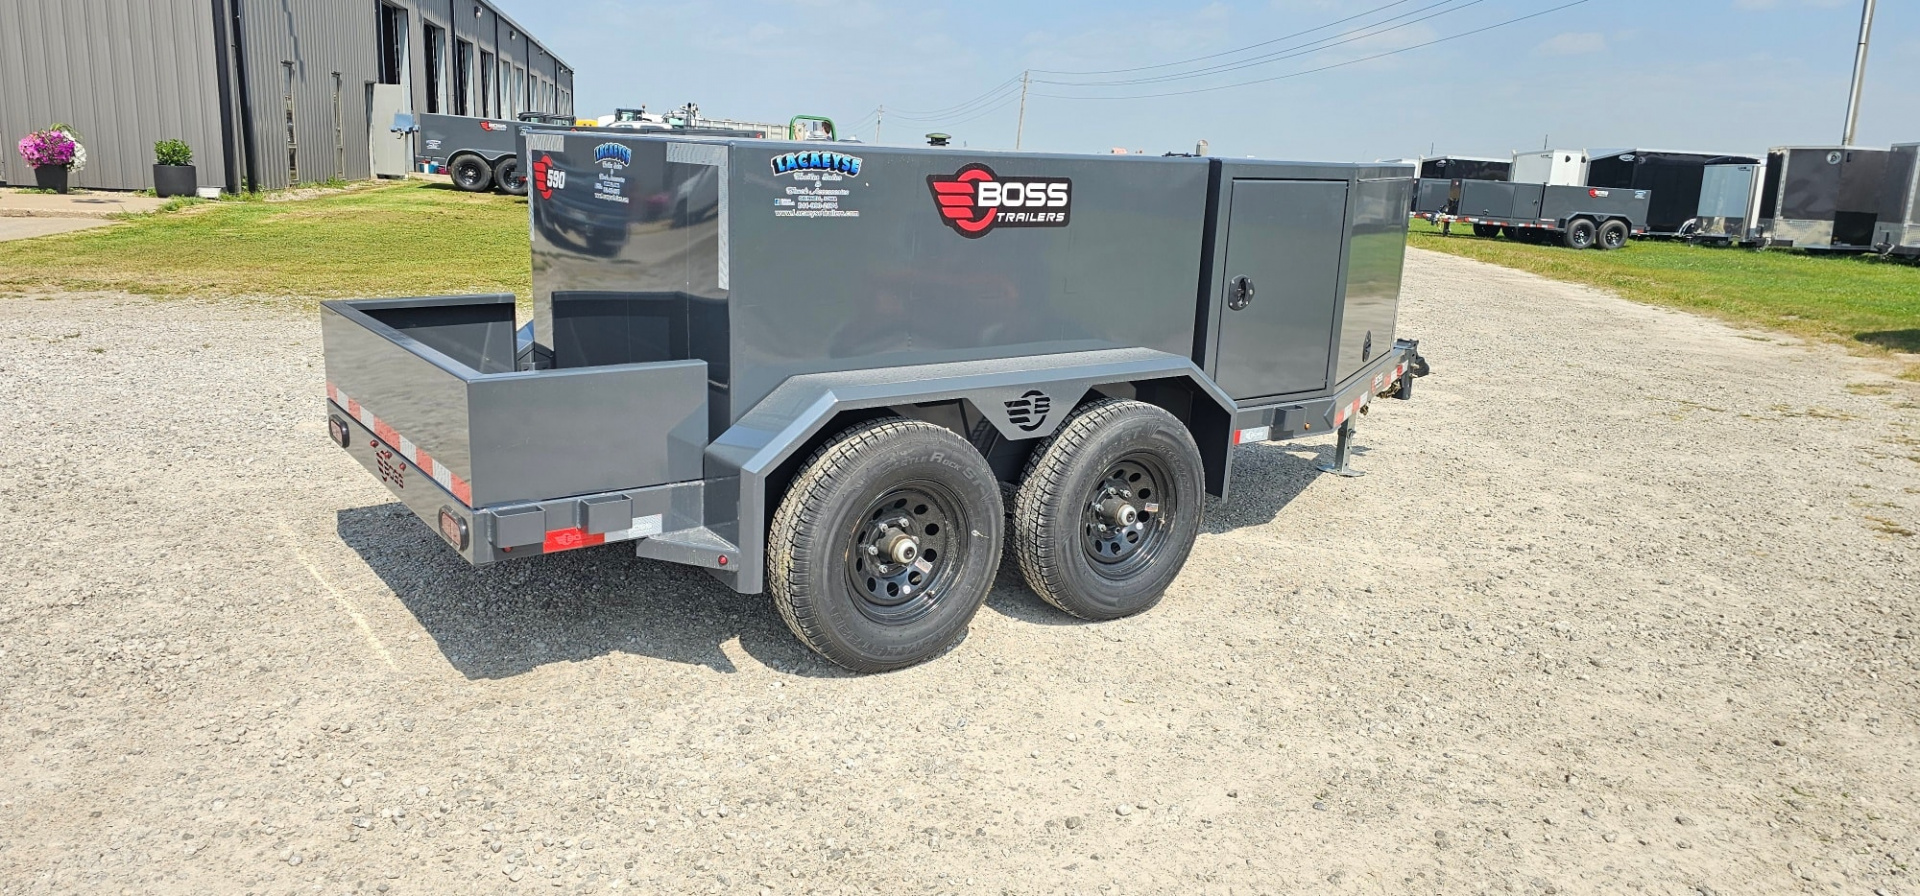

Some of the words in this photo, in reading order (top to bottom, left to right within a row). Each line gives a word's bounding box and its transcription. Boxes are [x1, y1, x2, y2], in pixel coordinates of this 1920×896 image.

[773, 151, 862, 176] LACAEYSE
[546, 169, 566, 189] 590
[977, 181, 1069, 207] BOSS
[996, 212, 1066, 223] TRAILERS
